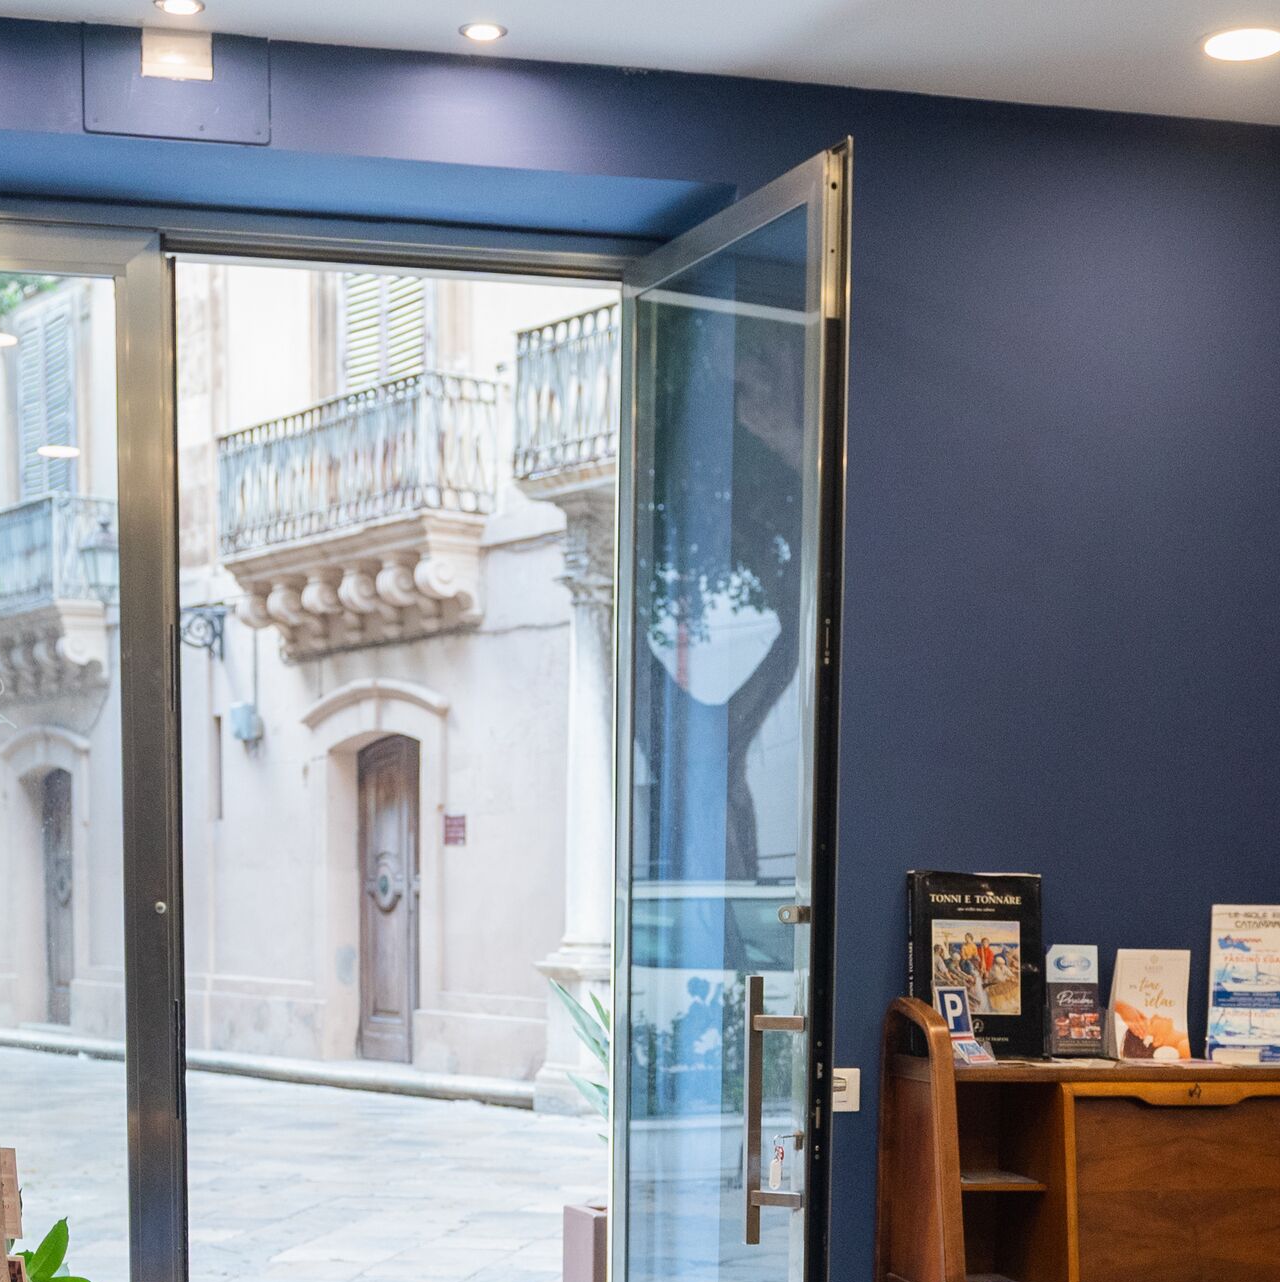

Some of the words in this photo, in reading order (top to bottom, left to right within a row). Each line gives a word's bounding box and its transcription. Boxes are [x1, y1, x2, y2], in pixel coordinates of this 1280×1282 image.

[929, 894, 961, 903] TONNI
[964, 895, 972, 904] E
[975, 895, 1022, 905] TONNARE
[1224, 955, 1260, 963] FASCINO
[943, 993, 963, 1029] P
